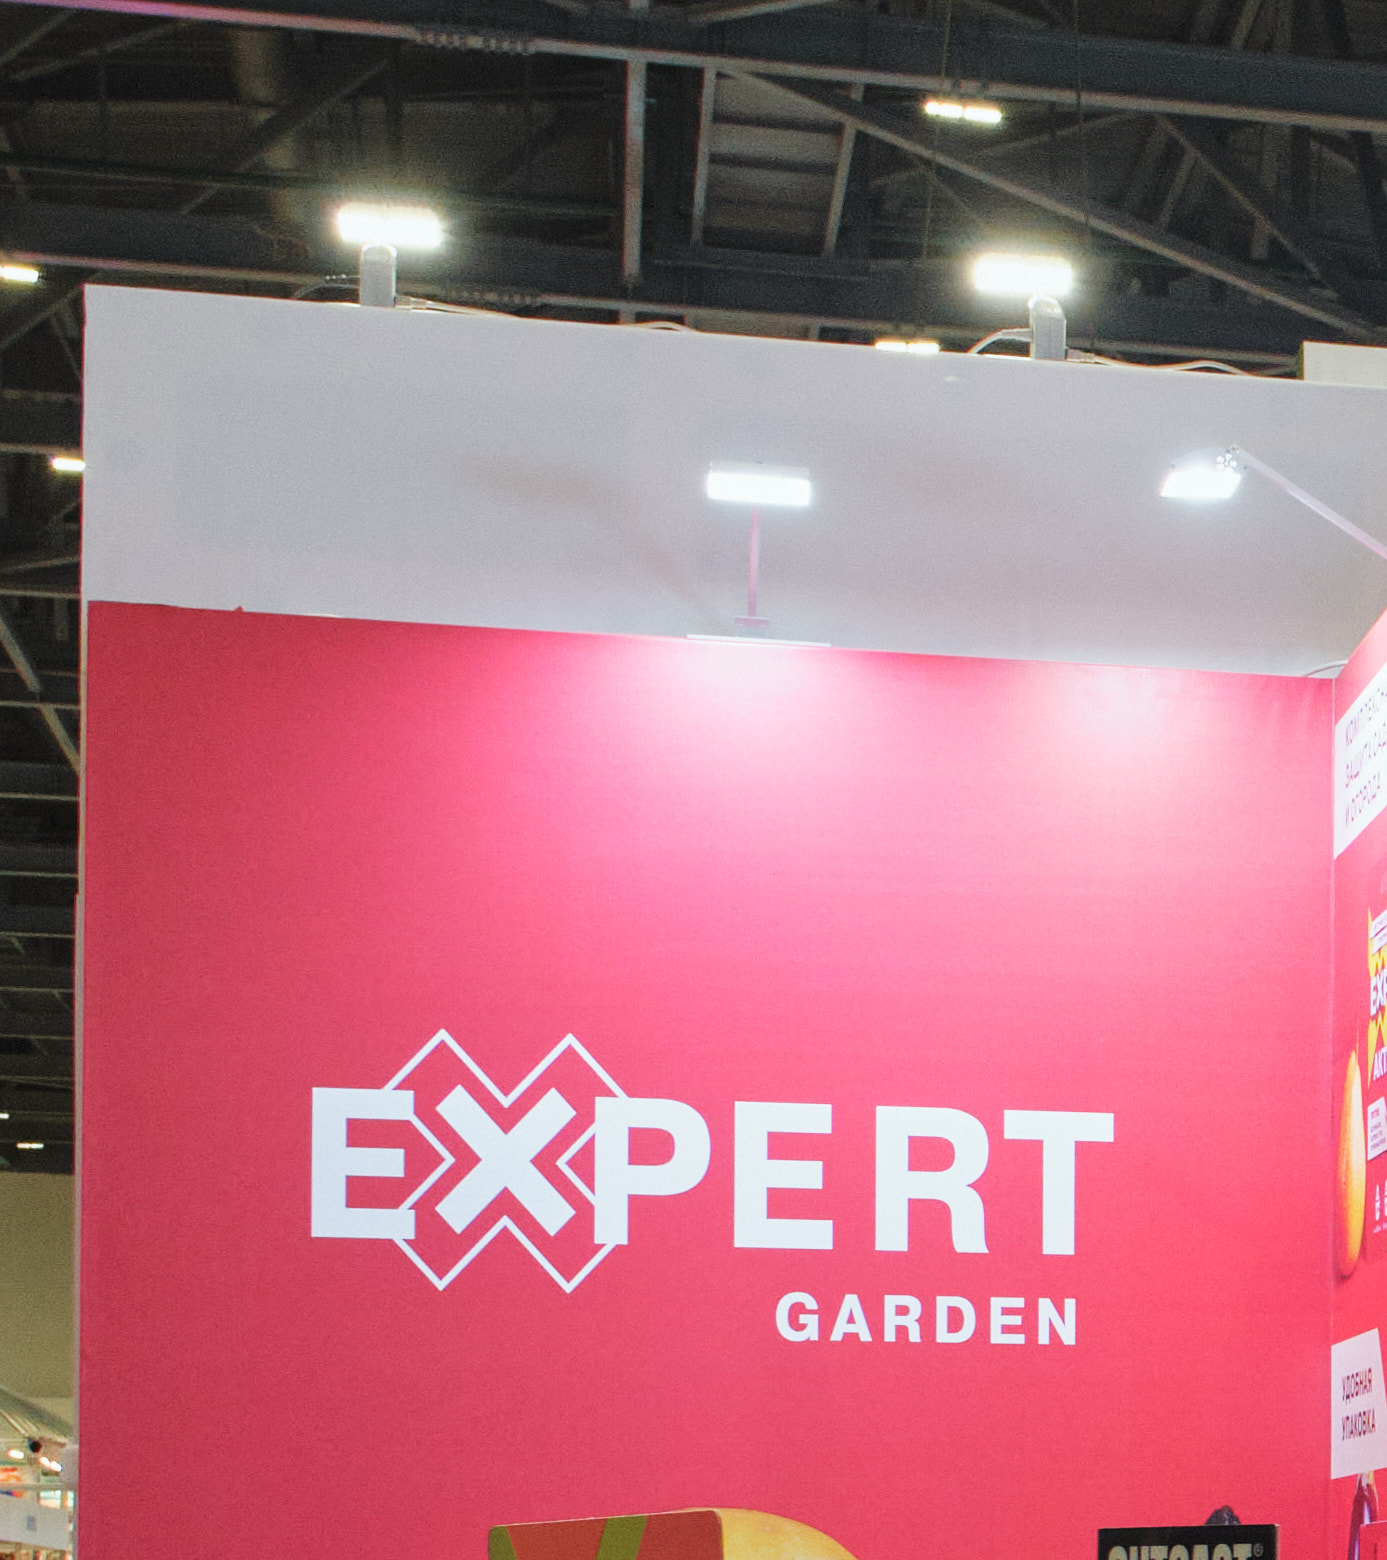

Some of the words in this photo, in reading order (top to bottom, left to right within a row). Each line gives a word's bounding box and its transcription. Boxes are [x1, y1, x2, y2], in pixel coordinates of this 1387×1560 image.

[311, 1084, 1114, 1257] EXPERT
[774, 1290, 1077, 1346] GARDEN
[1342, 1367, 1373, 1404] УДОБНАЯ
[1342, 1407, 1376, 1441] УПАКОВКА
